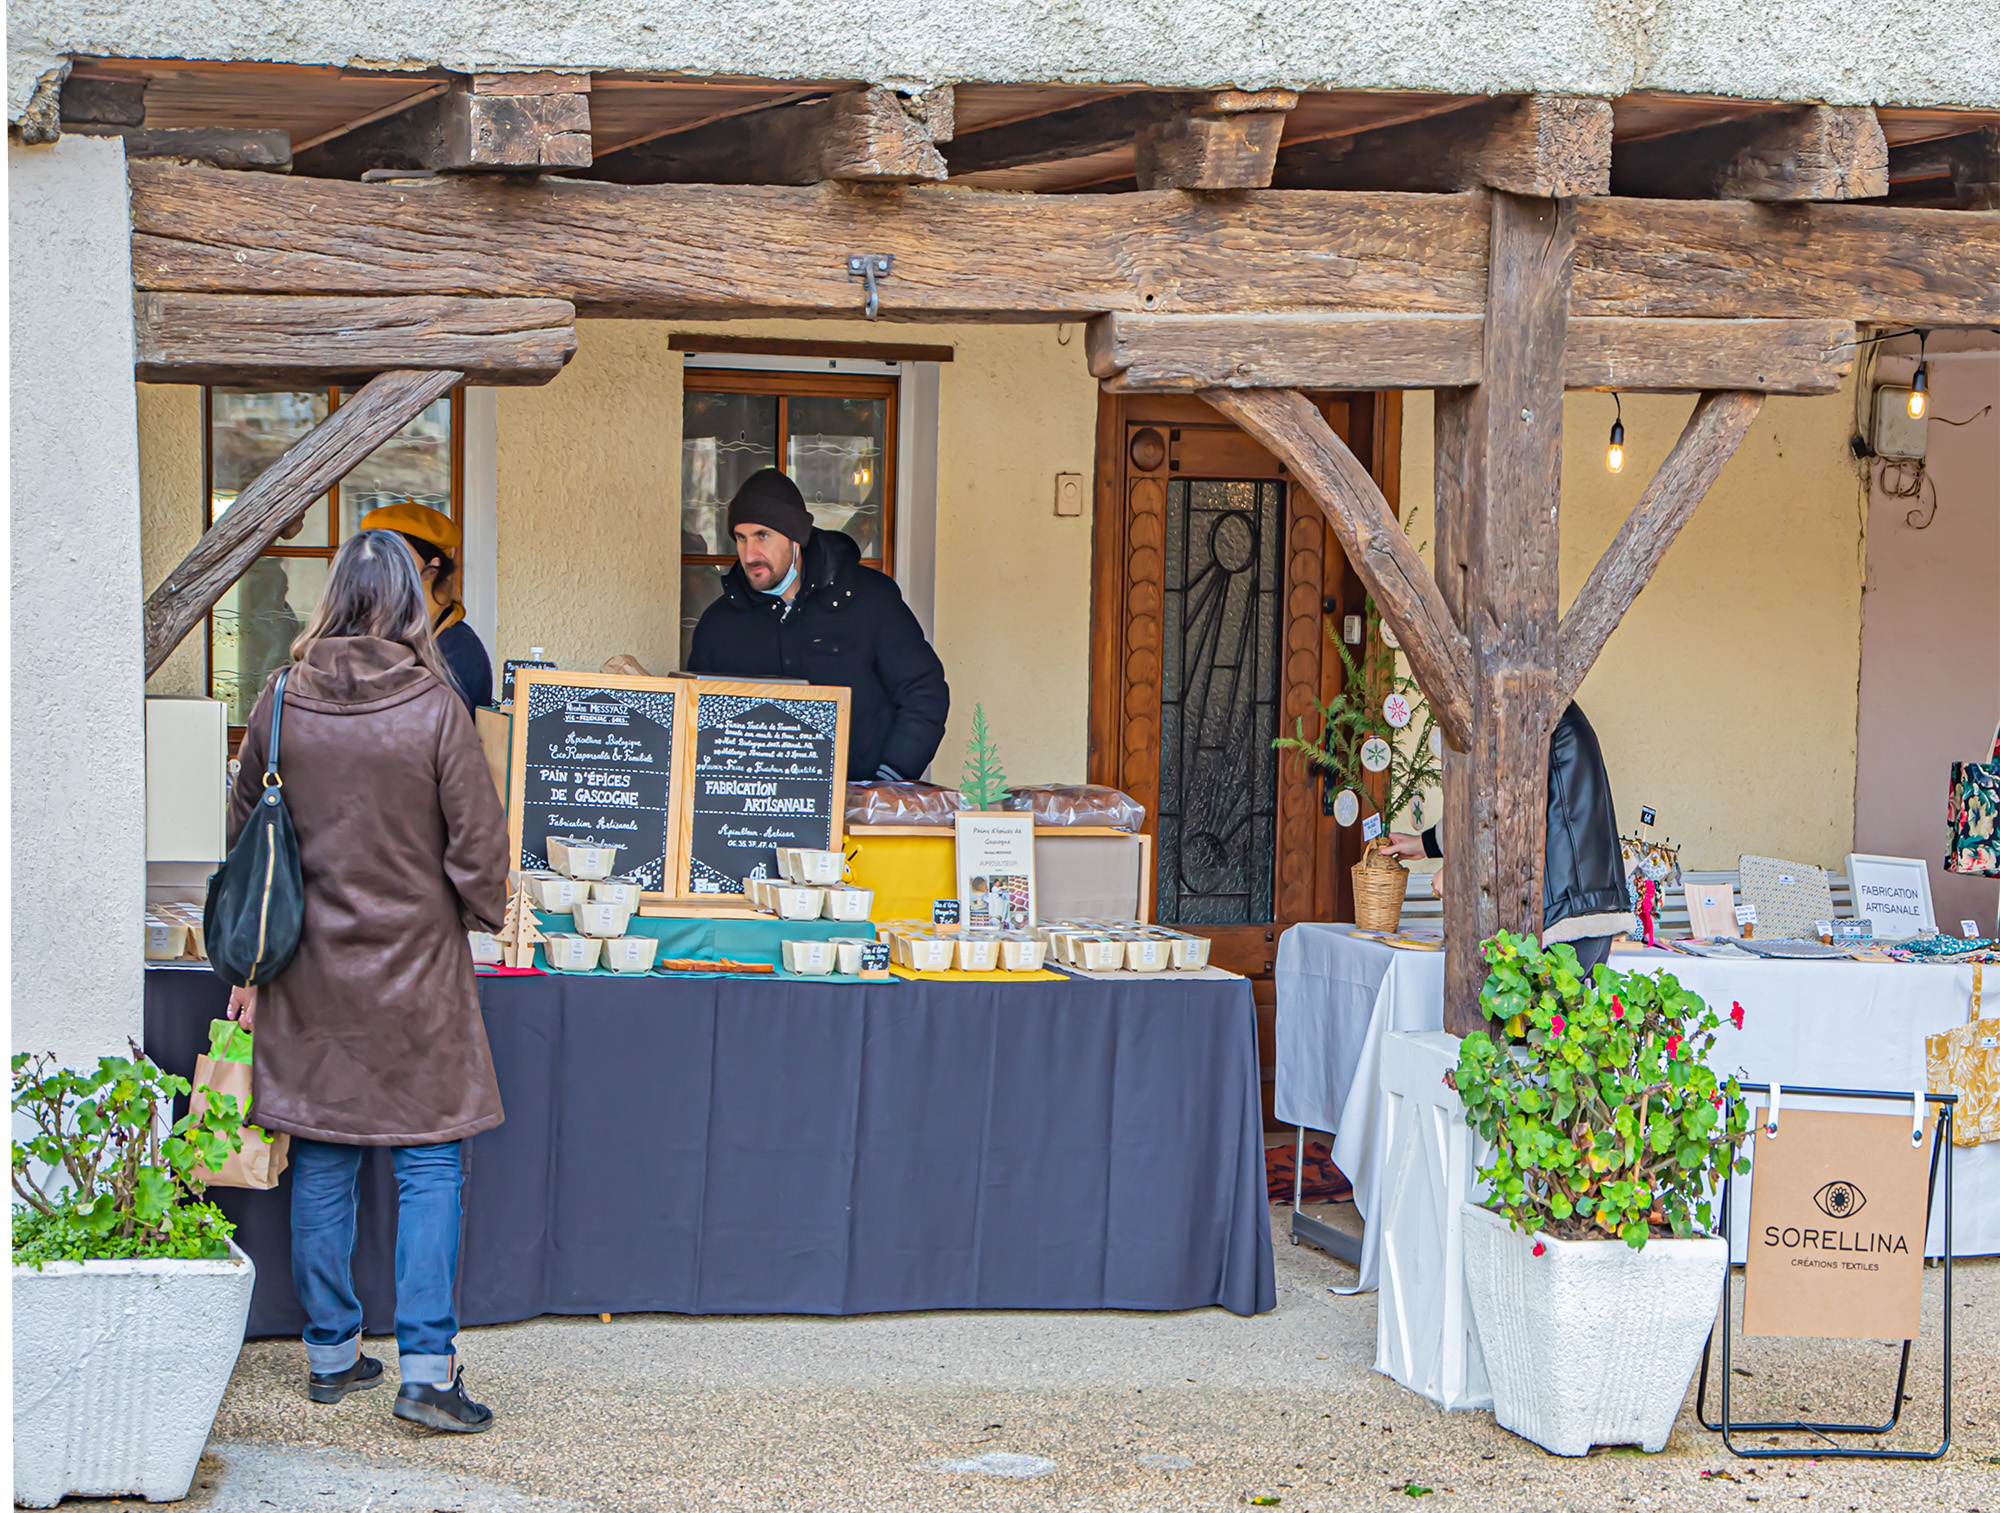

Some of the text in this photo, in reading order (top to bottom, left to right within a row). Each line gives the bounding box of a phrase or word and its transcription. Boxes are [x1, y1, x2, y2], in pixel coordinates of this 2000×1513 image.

[590, 704, 628, 715] MESSYASZ
[605, 734, 642, 749] Biologique
[540, 770, 631, 787] PAIN D'ÉPICES
[705, 780, 777, 796] FABRICATION
[550, 788, 639, 806] DE GASCOGNE
[743, 797, 815, 813] ARTISANALE
[548, 814, 638, 830] Fabrication Artisanale
[763, 826, 795, 838] Artisan
[1861, 885, 1918, 899] FABRICATION
[1866, 902, 1920, 916] ARTISANALE
[1764, 1226, 1909, 1254] SORELLINA
[1791, 1258, 1880, 1272] CRÉATIONS TEXTILES
